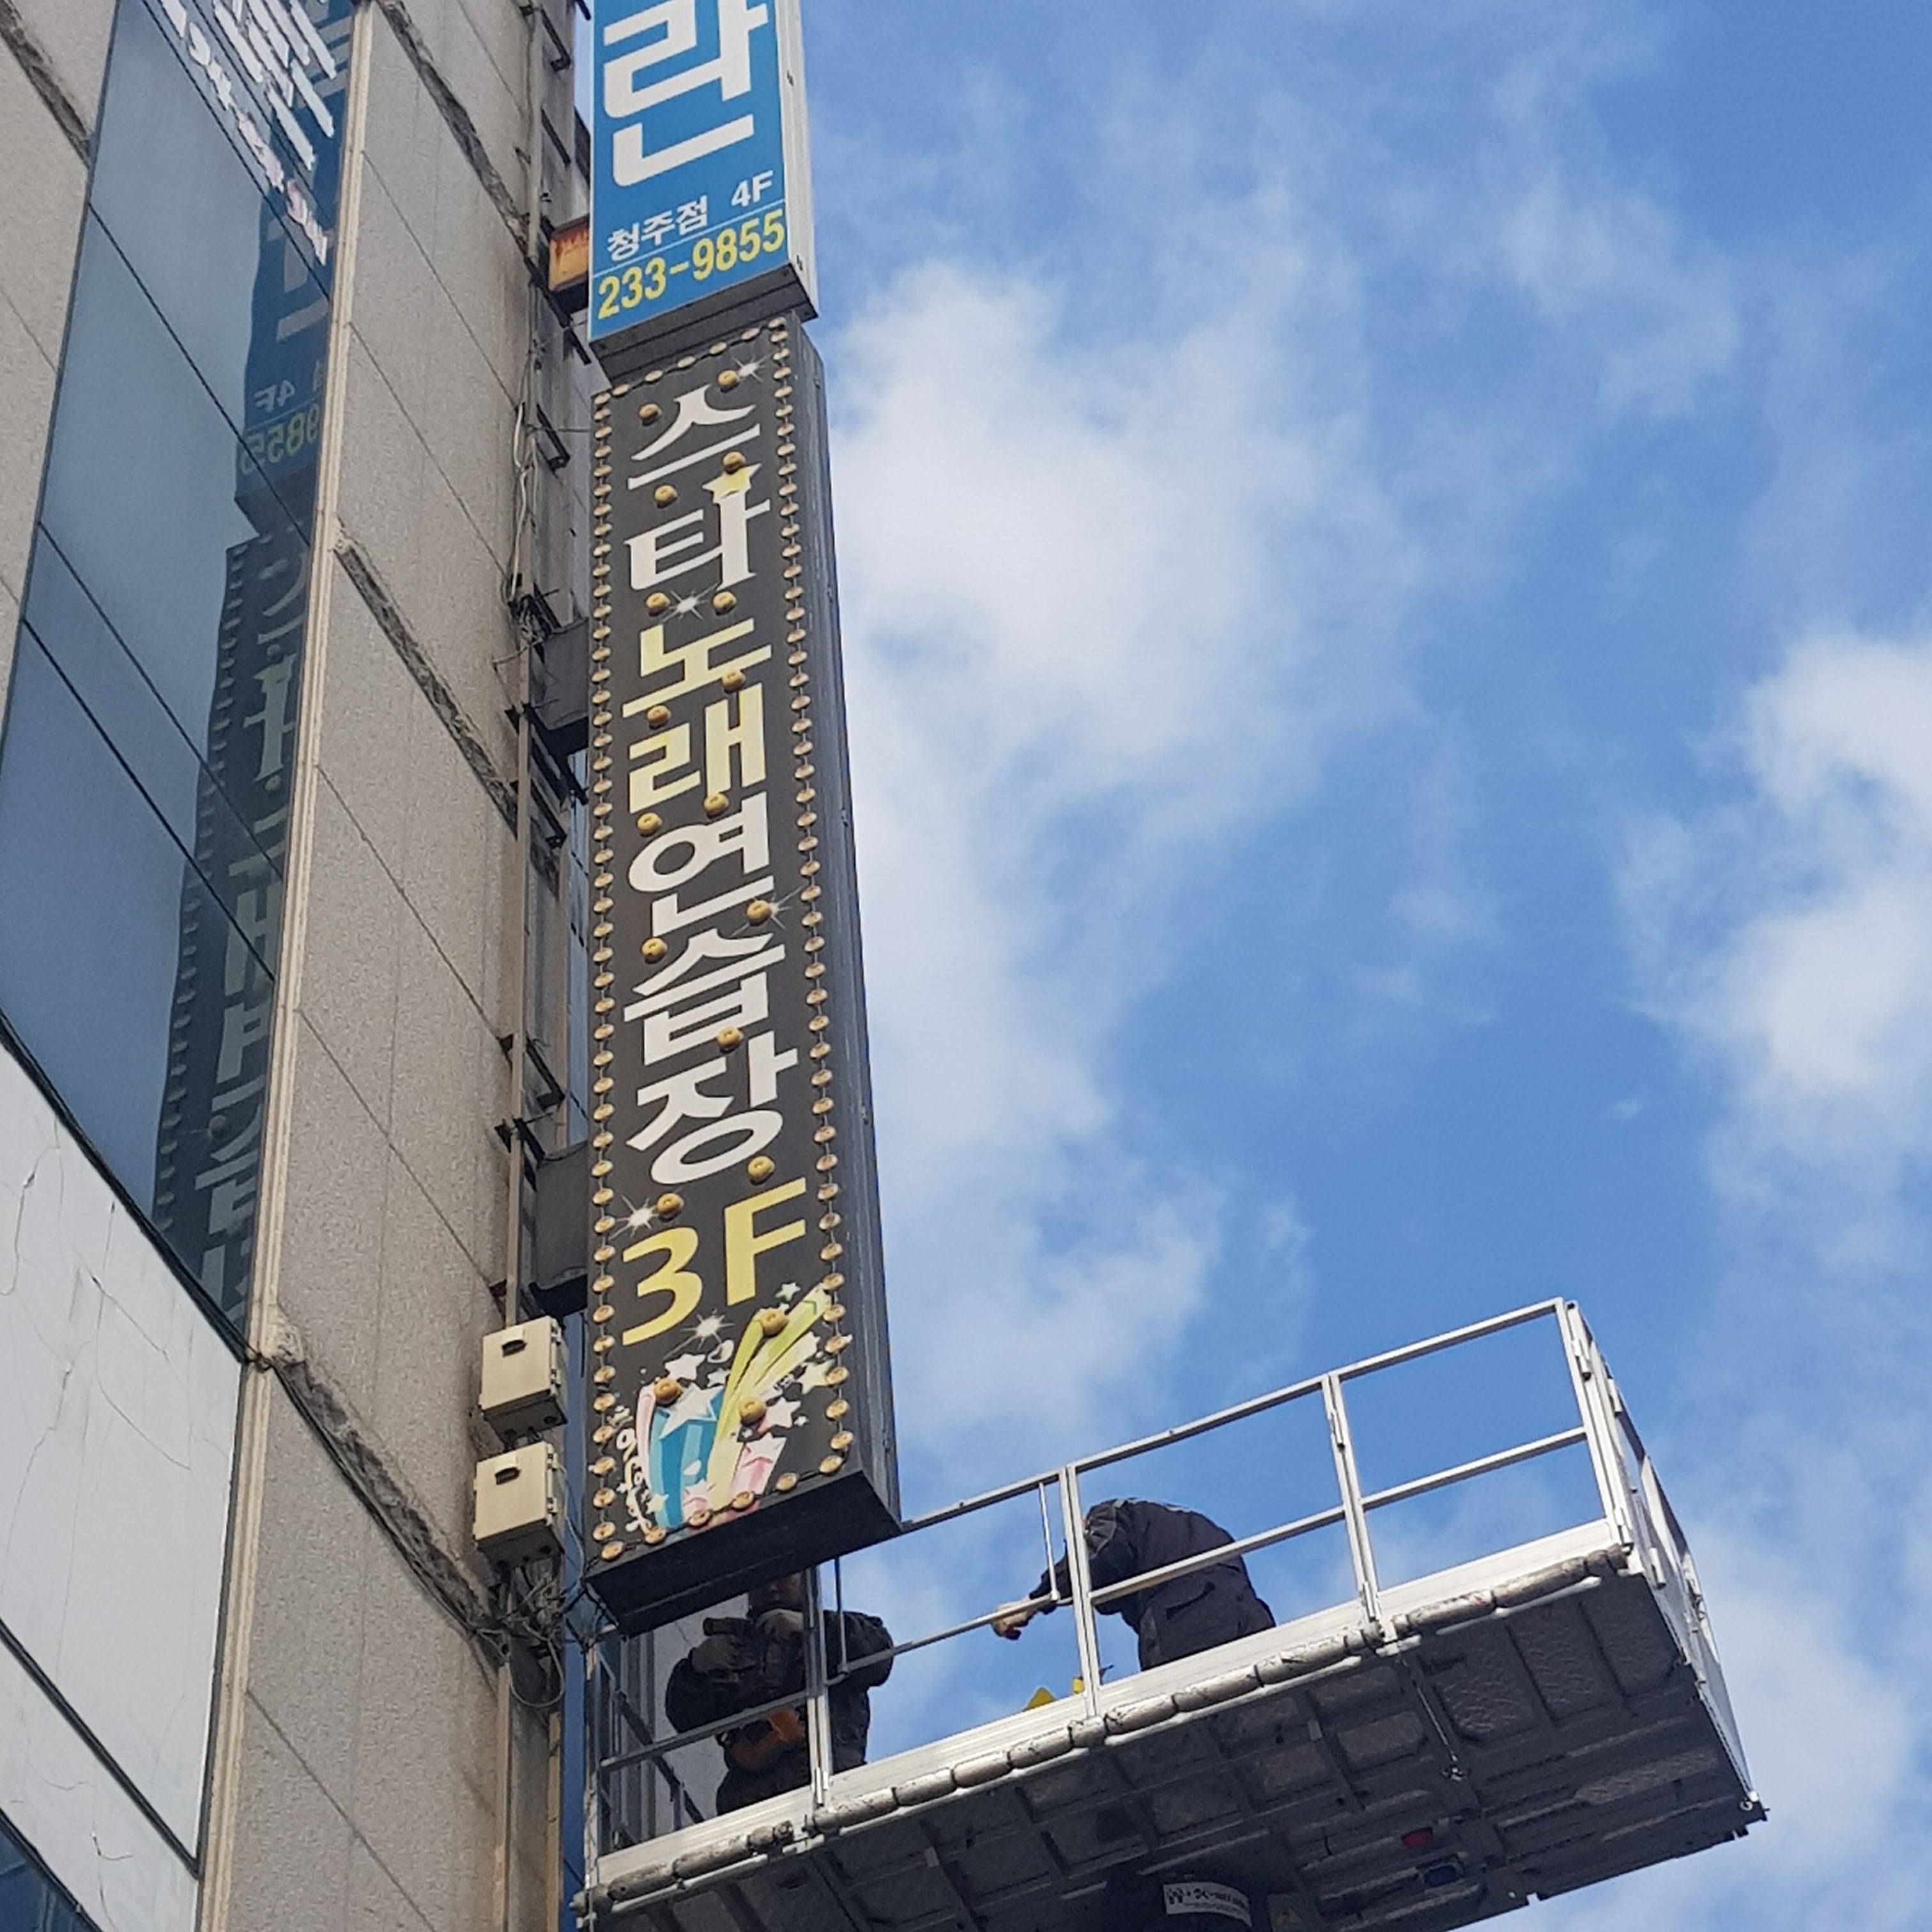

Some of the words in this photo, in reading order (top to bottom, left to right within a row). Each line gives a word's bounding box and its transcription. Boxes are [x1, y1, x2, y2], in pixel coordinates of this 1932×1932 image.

[597, 208, 785, 320] 233-9855
[607, 195, 709, 262] 청주점
[730, 170, 774, 208] 4F
[622, 1177, 806, 1346] 3F
